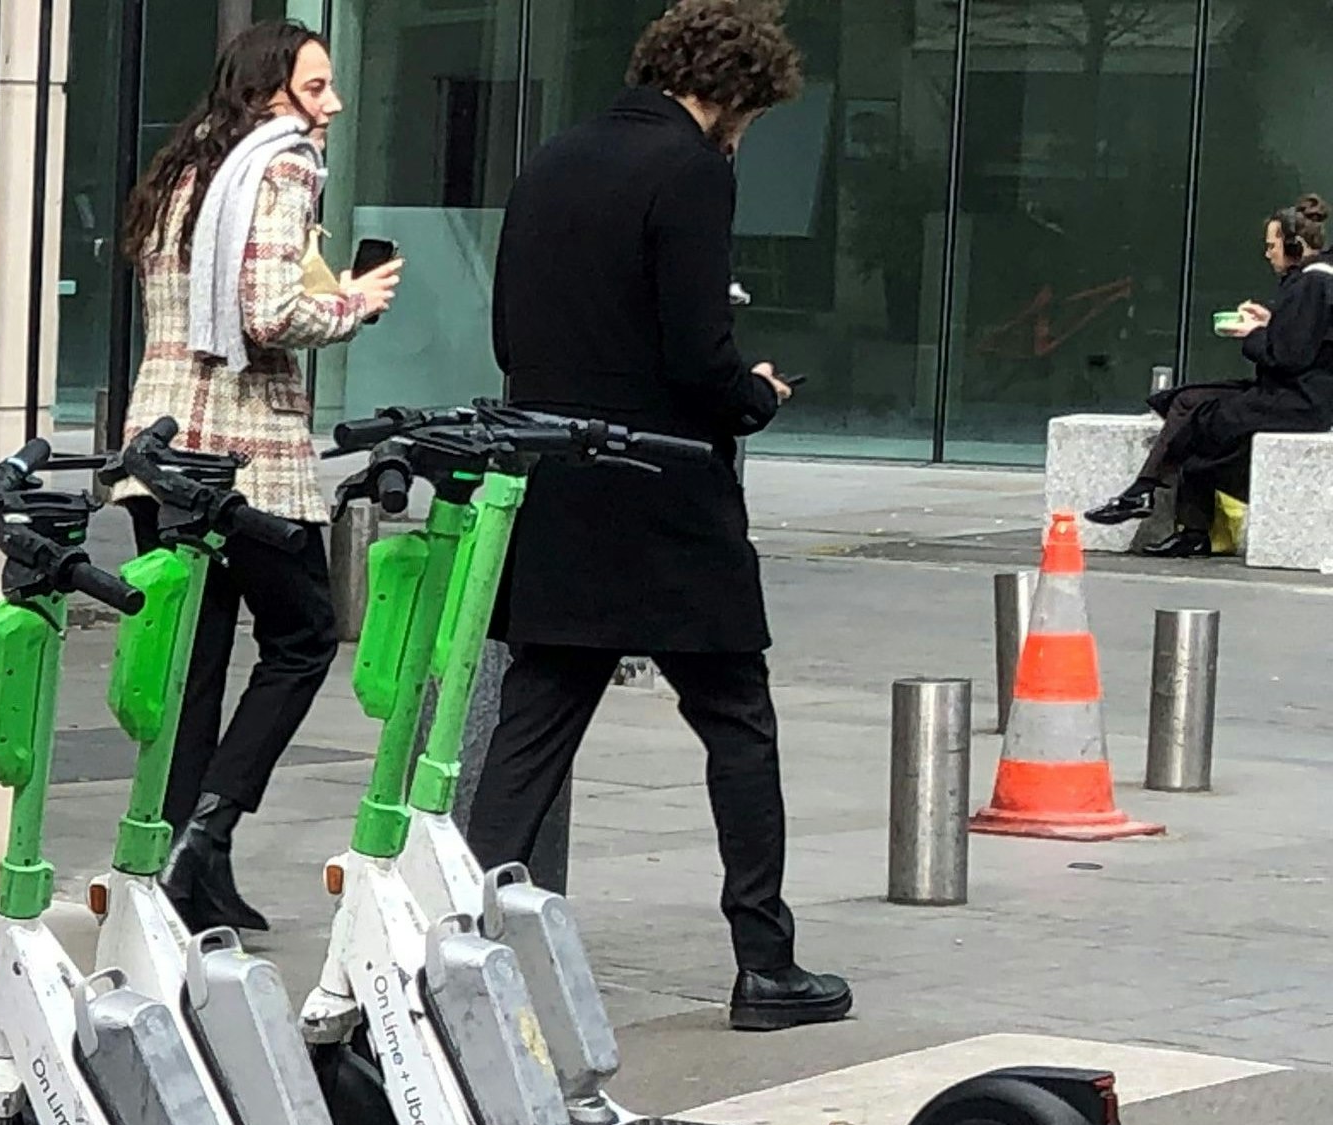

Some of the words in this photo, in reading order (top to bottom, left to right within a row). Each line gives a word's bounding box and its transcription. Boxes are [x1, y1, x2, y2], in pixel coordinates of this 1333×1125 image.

[374, 975, 389, 1009] On
[381, 1011, 404, 1066] Lime
[32, 1058, 50, 1093] On
